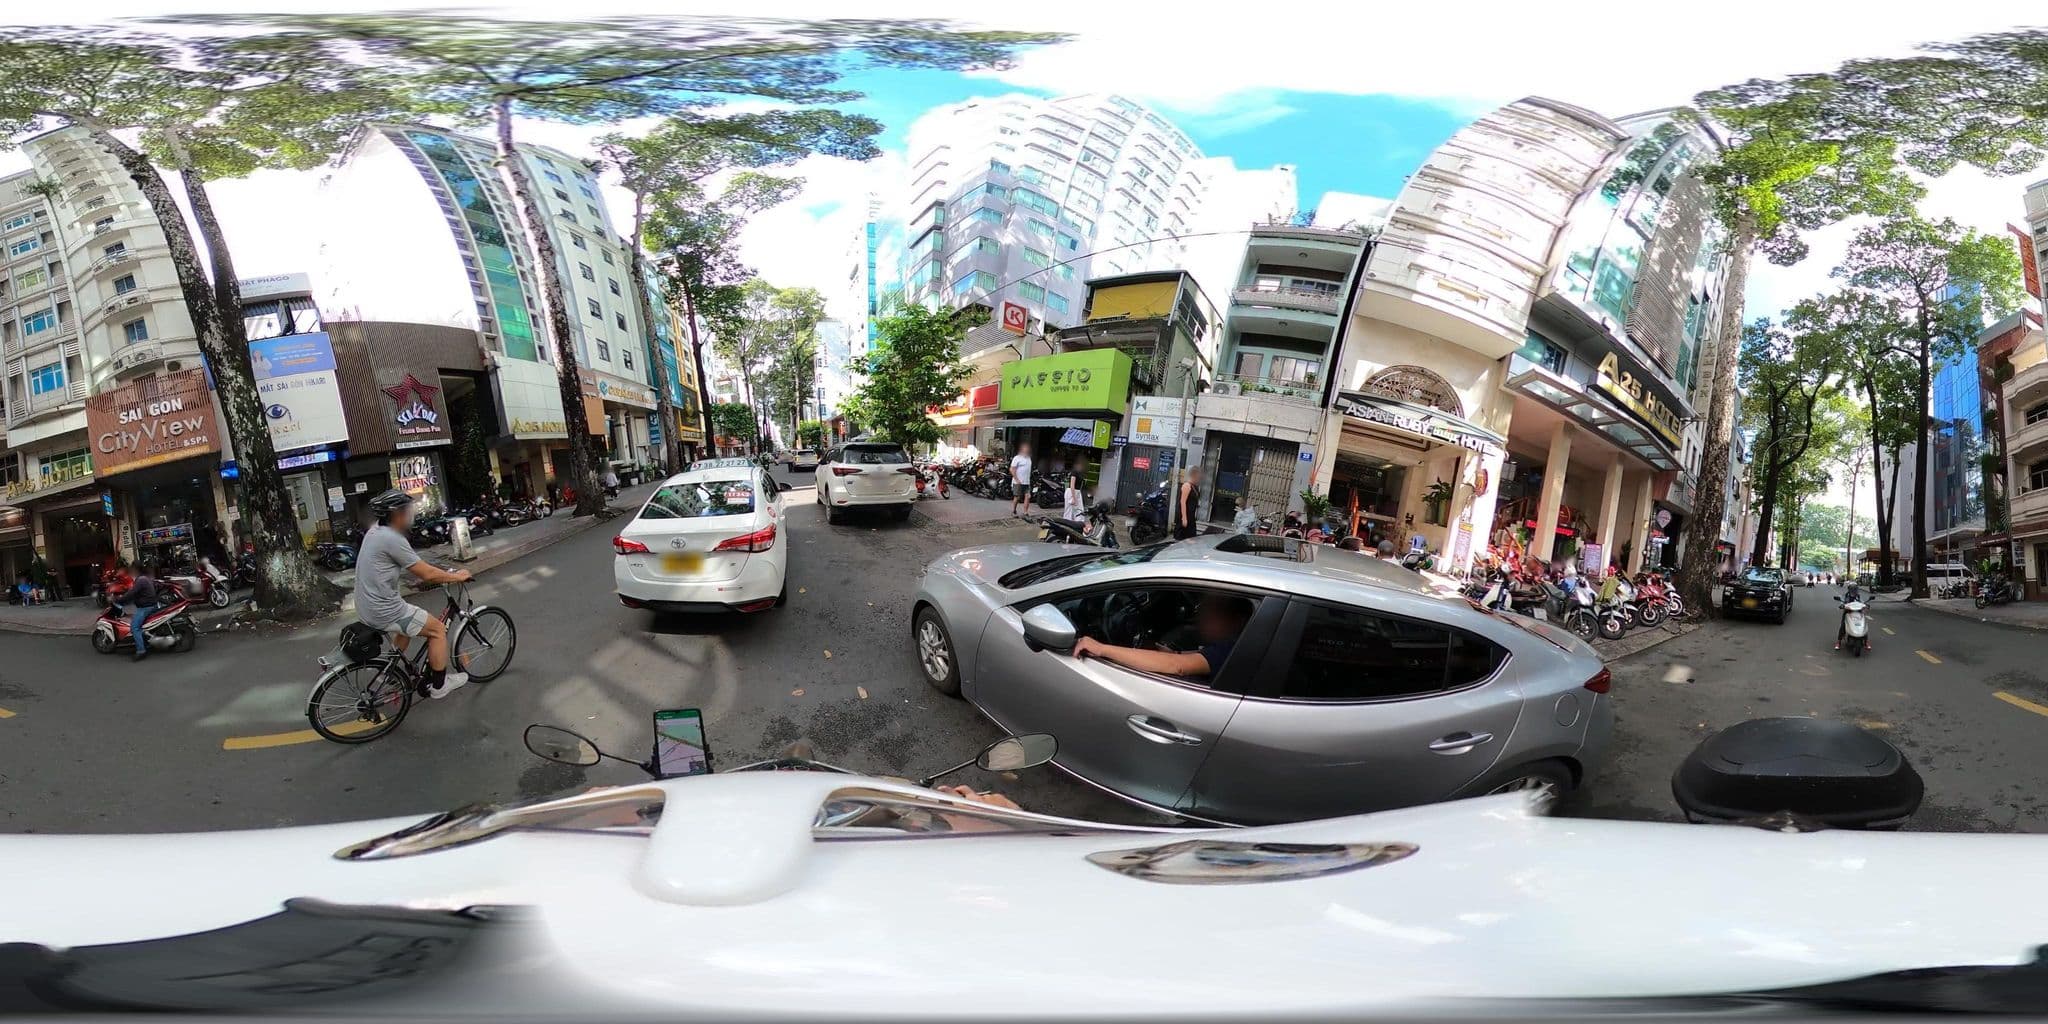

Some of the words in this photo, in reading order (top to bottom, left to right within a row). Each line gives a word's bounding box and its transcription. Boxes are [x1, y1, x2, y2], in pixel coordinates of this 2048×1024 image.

[1010, 311, 1021, 324] K
[1011, 368, 1092, 389] PASSIO
[1597, 351, 1643, 400] A25
[1393, 415, 1431, 436] RUBY
[146, 439, 183, 455] HOTEL
